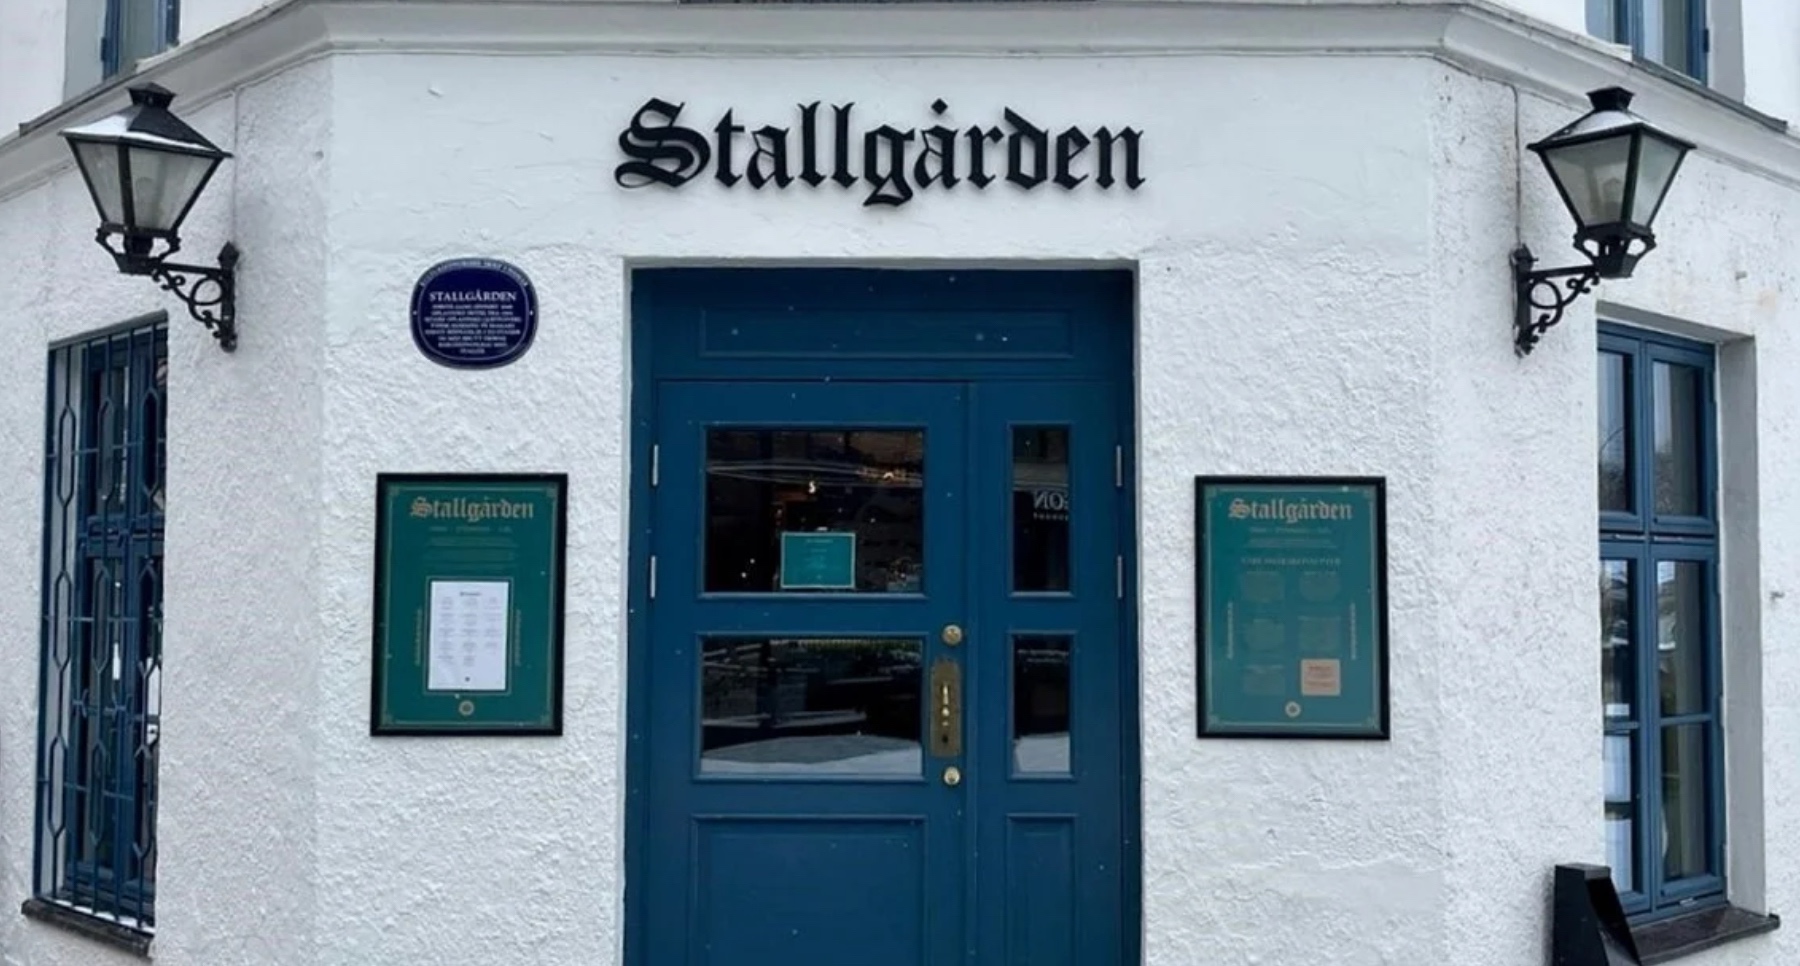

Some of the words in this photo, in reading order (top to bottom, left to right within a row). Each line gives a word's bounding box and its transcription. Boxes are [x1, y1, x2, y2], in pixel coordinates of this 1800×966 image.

[614, 98, 1146, 207] Stallgården
[429, 288, 517, 302] STALLGÅRDEN
[410, 496, 535, 523] Stallgården
[1227, 497, 1353, 524] Stallgården
